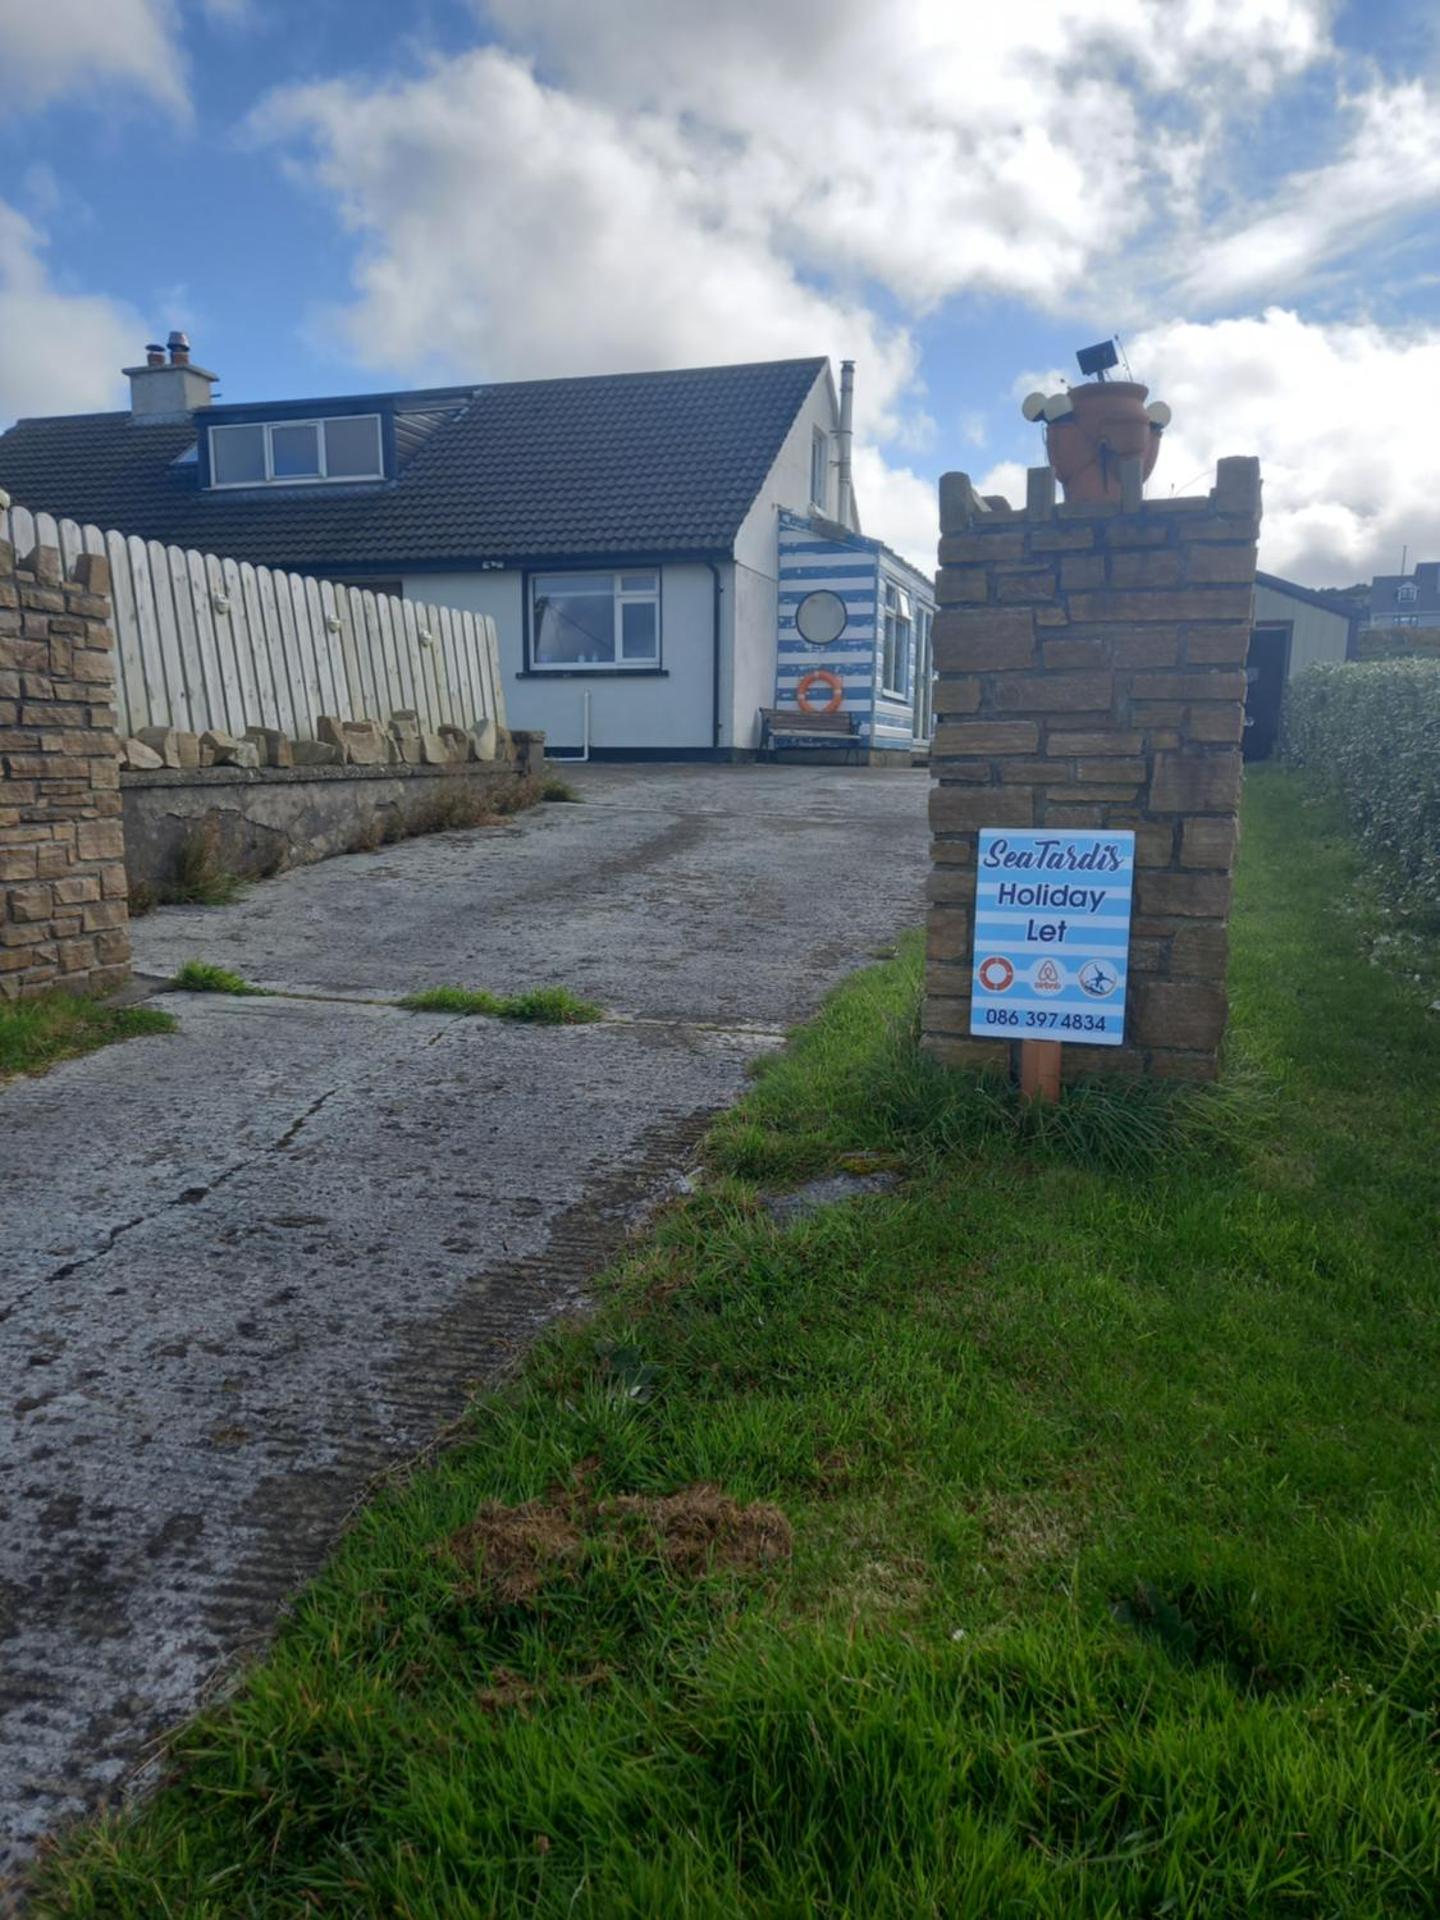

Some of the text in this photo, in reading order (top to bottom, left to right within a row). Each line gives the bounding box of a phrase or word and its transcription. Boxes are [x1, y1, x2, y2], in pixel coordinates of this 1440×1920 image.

[983, 839, 1123, 872] SeaTardis
[998, 883, 1105, 912] Holiday
[1027, 919, 1067, 942] Let
[986, 1008, 1019, 1025] 086
